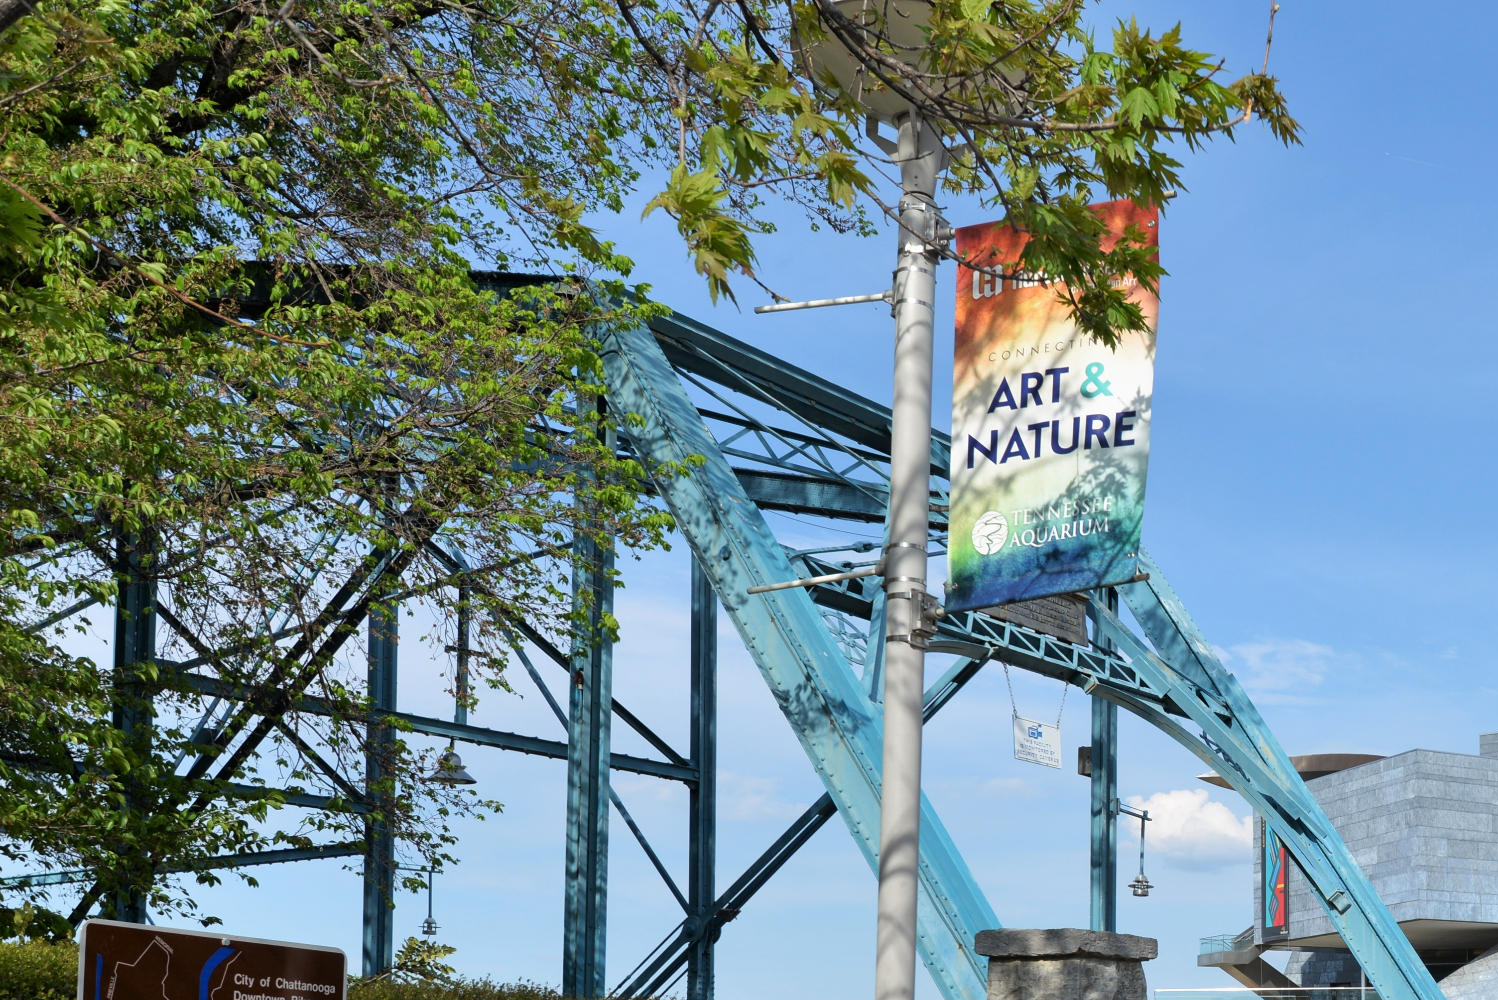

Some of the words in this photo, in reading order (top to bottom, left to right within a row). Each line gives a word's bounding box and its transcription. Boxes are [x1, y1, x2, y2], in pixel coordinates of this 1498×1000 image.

[988, 335, 1101, 362] CONNECTIN
[987, 366, 1070, 414] ART
[1080, 361, 1113, 399] &
[967, 410, 1137, 469] NATURE
[1009, 495, 1113, 526] TENNESSEE
[1009, 517, 1109, 548] AQUARIUM
[234, 973, 255, 988] City
[260, 976, 271, 987] of
[275, 977, 336, 995] Chattanooga
